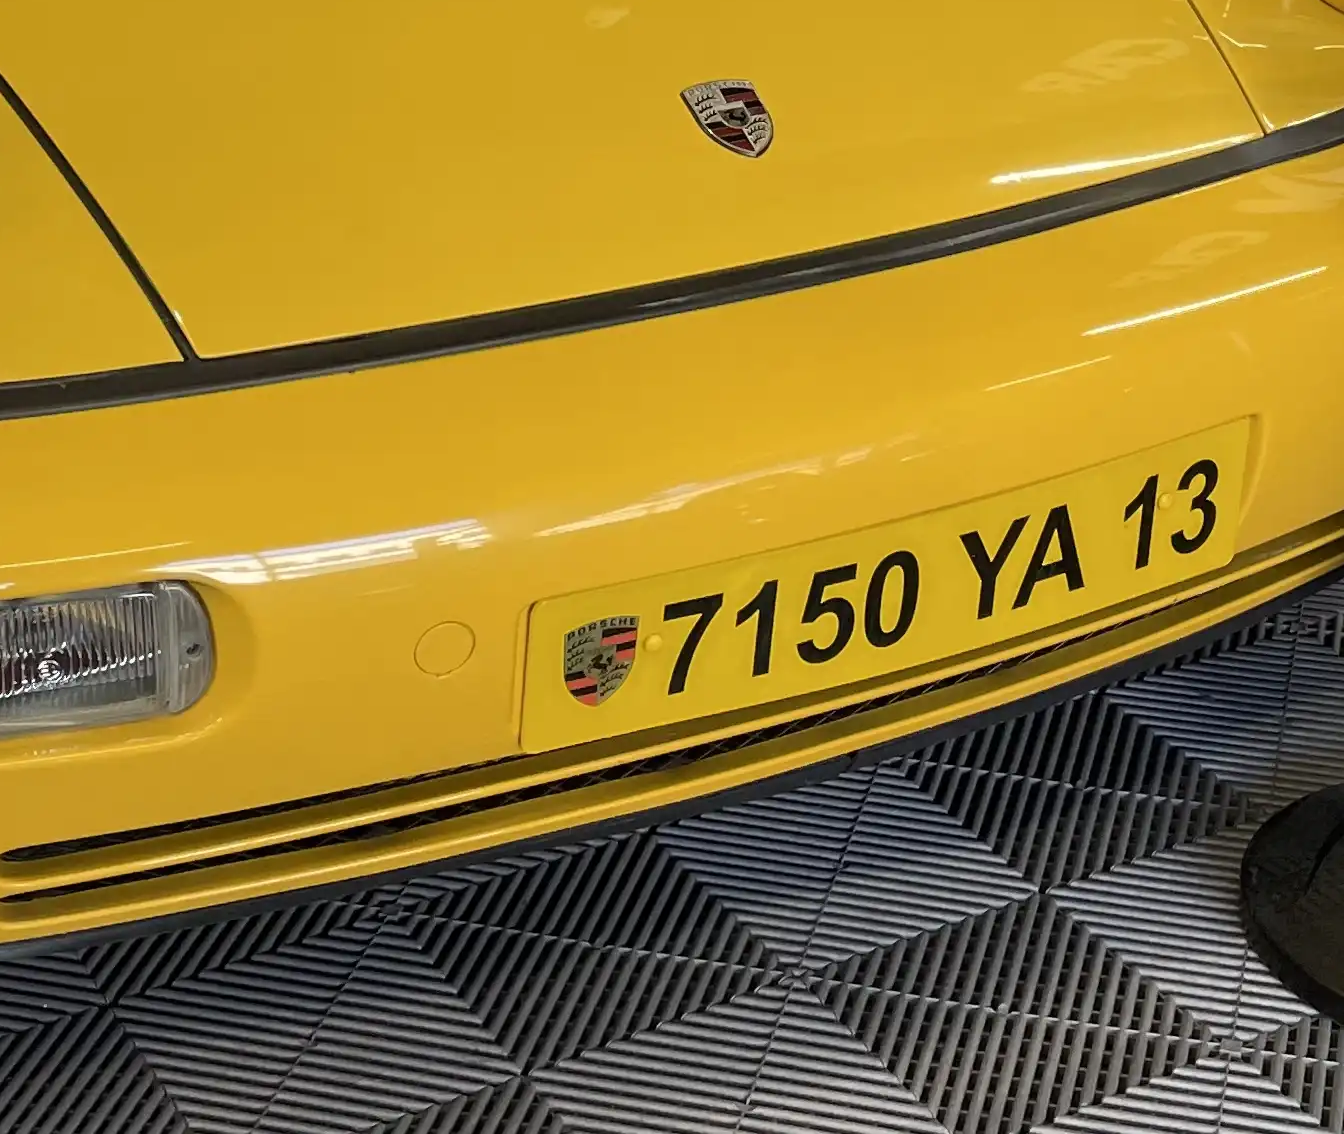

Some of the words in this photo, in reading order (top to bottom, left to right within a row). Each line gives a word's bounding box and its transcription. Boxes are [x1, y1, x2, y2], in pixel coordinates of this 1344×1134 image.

[567, 617, 637, 641] PORSCHE
[663, 550, 920, 696] 7150
[959, 503, 1086, 620] YA
[1123, 458, 1220, 570] 13
